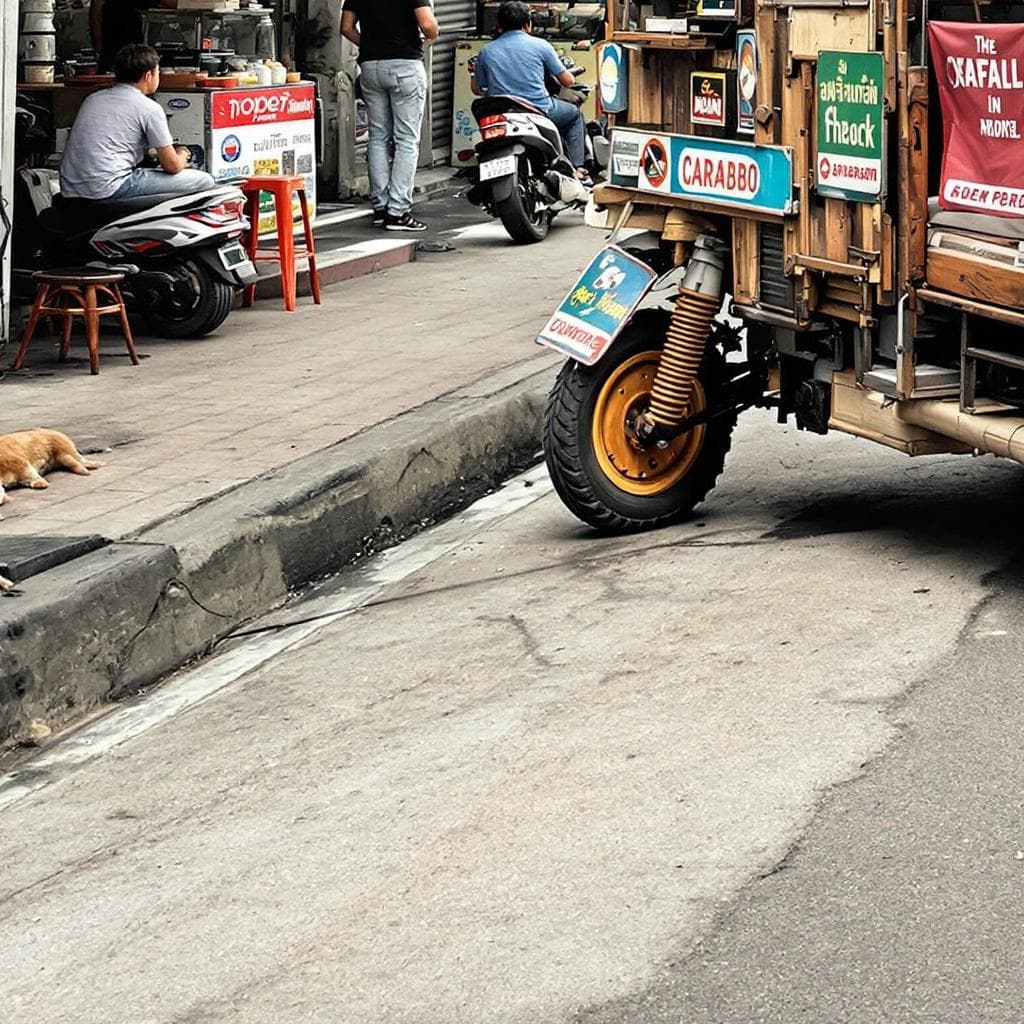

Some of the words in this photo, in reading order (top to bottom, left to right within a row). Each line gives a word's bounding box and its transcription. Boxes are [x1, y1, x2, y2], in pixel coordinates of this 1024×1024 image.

[974, 34, 997, 55] THE
[987, 95, 1001, 114] IN
[682, 155, 758, 193] CARABBO
